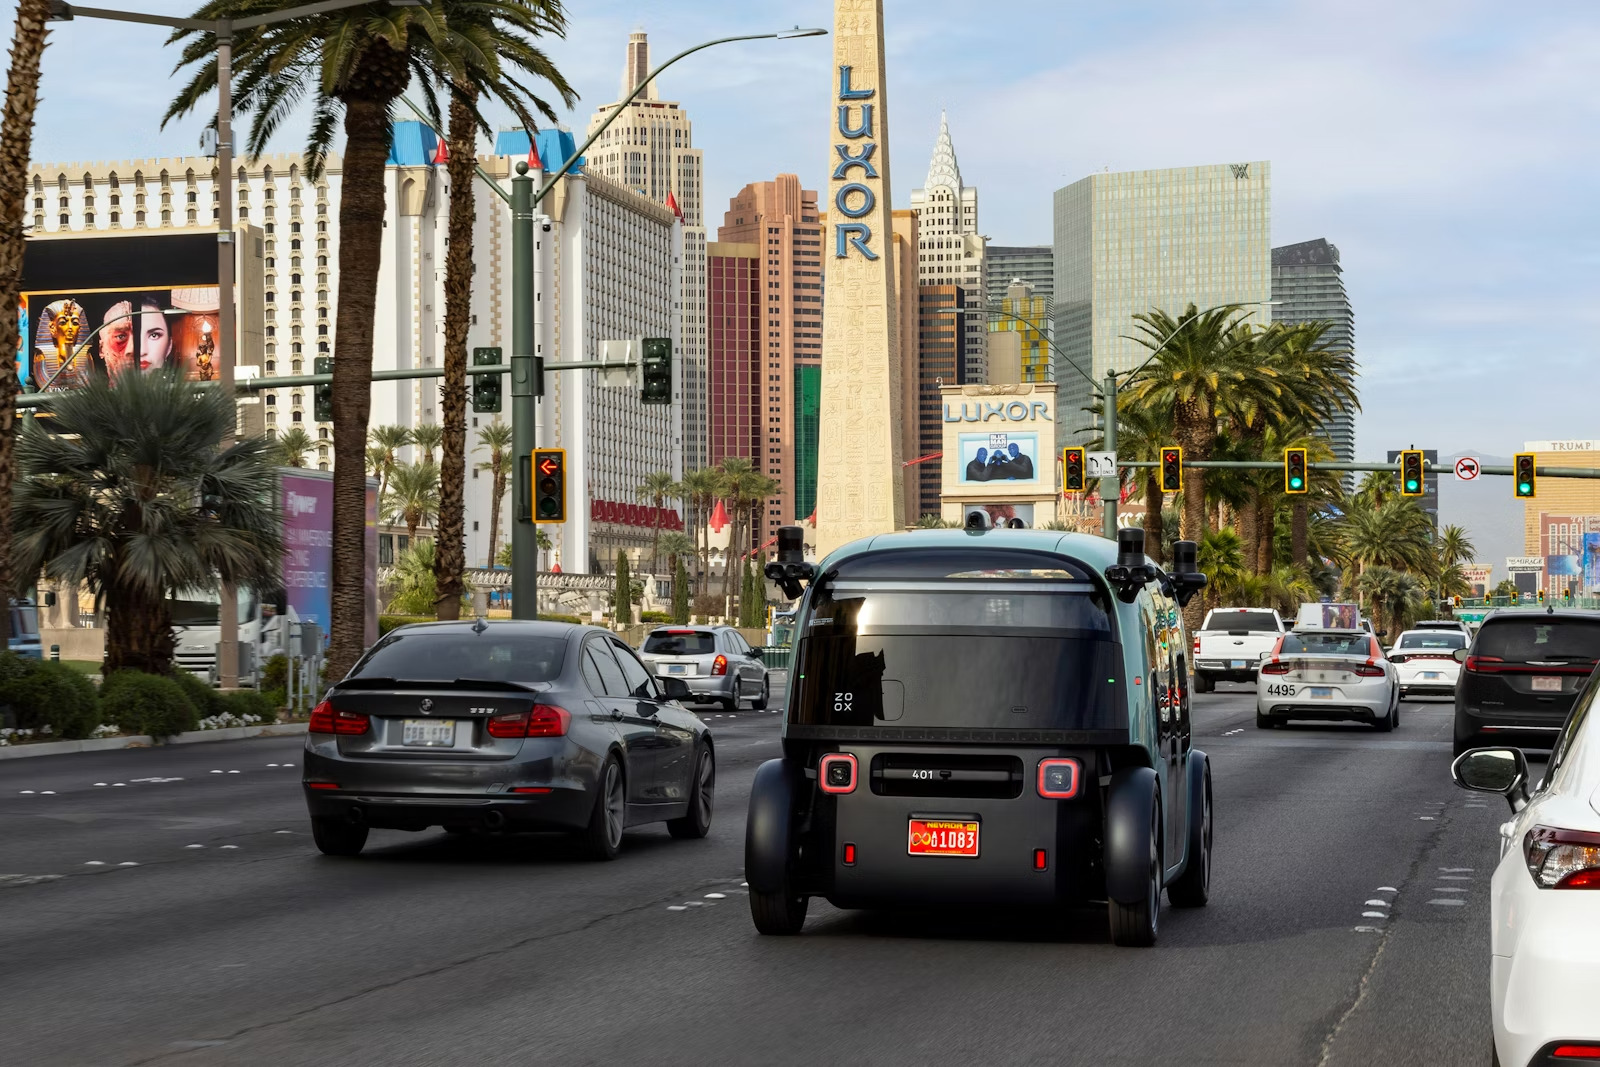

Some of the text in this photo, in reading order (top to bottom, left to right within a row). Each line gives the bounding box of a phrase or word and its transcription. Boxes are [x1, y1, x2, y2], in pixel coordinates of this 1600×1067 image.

[832, 65, 879, 260] LUXOR
[943, 401, 1053, 422] LUXOR
[1551, 441, 1592, 450] TRUMP
[1267, 684, 1296, 696] 4495
[912, 770, 933, 780] 401
